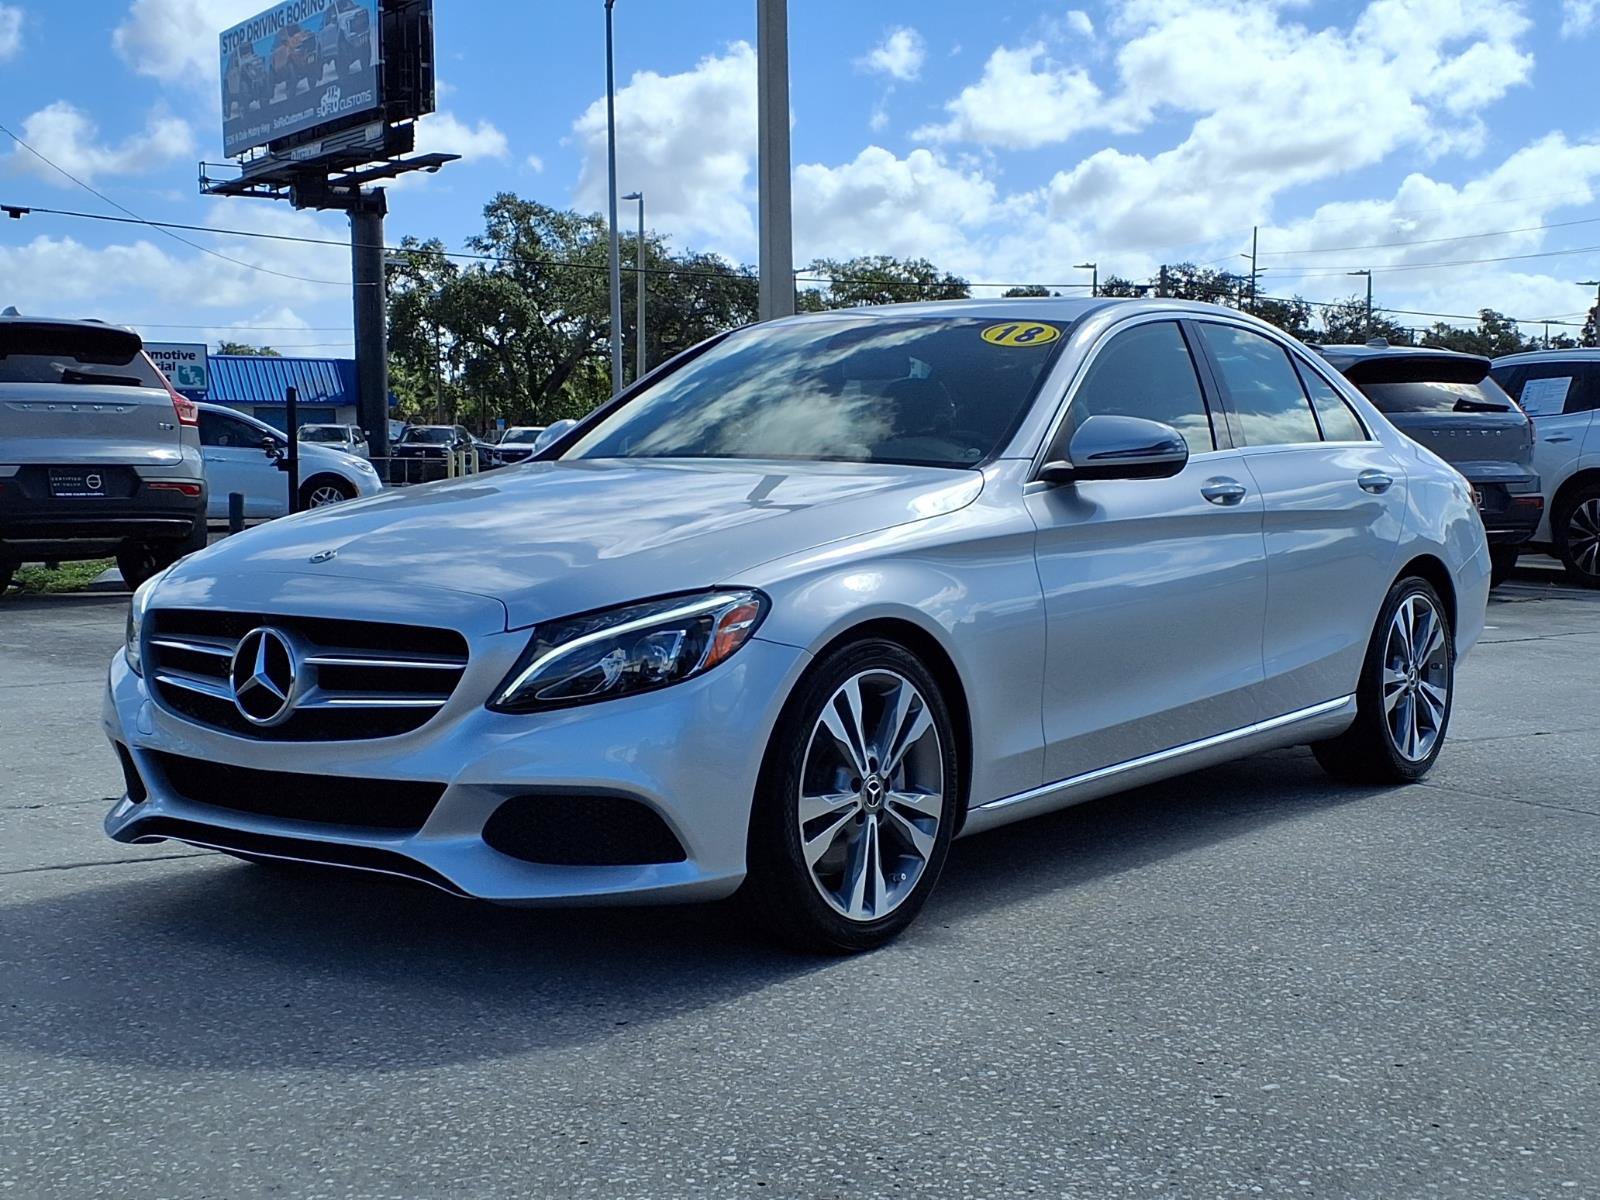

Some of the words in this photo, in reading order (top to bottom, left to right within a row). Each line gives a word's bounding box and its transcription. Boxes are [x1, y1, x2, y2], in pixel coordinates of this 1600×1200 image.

[223, 29, 245, 54] STOP
[247, 10, 284, 41] DRIVING
[287, 0, 325, 23] BORING
[340, 90, 372, 111] CUSTOMS
[994, 325, 1045, 342] 18
